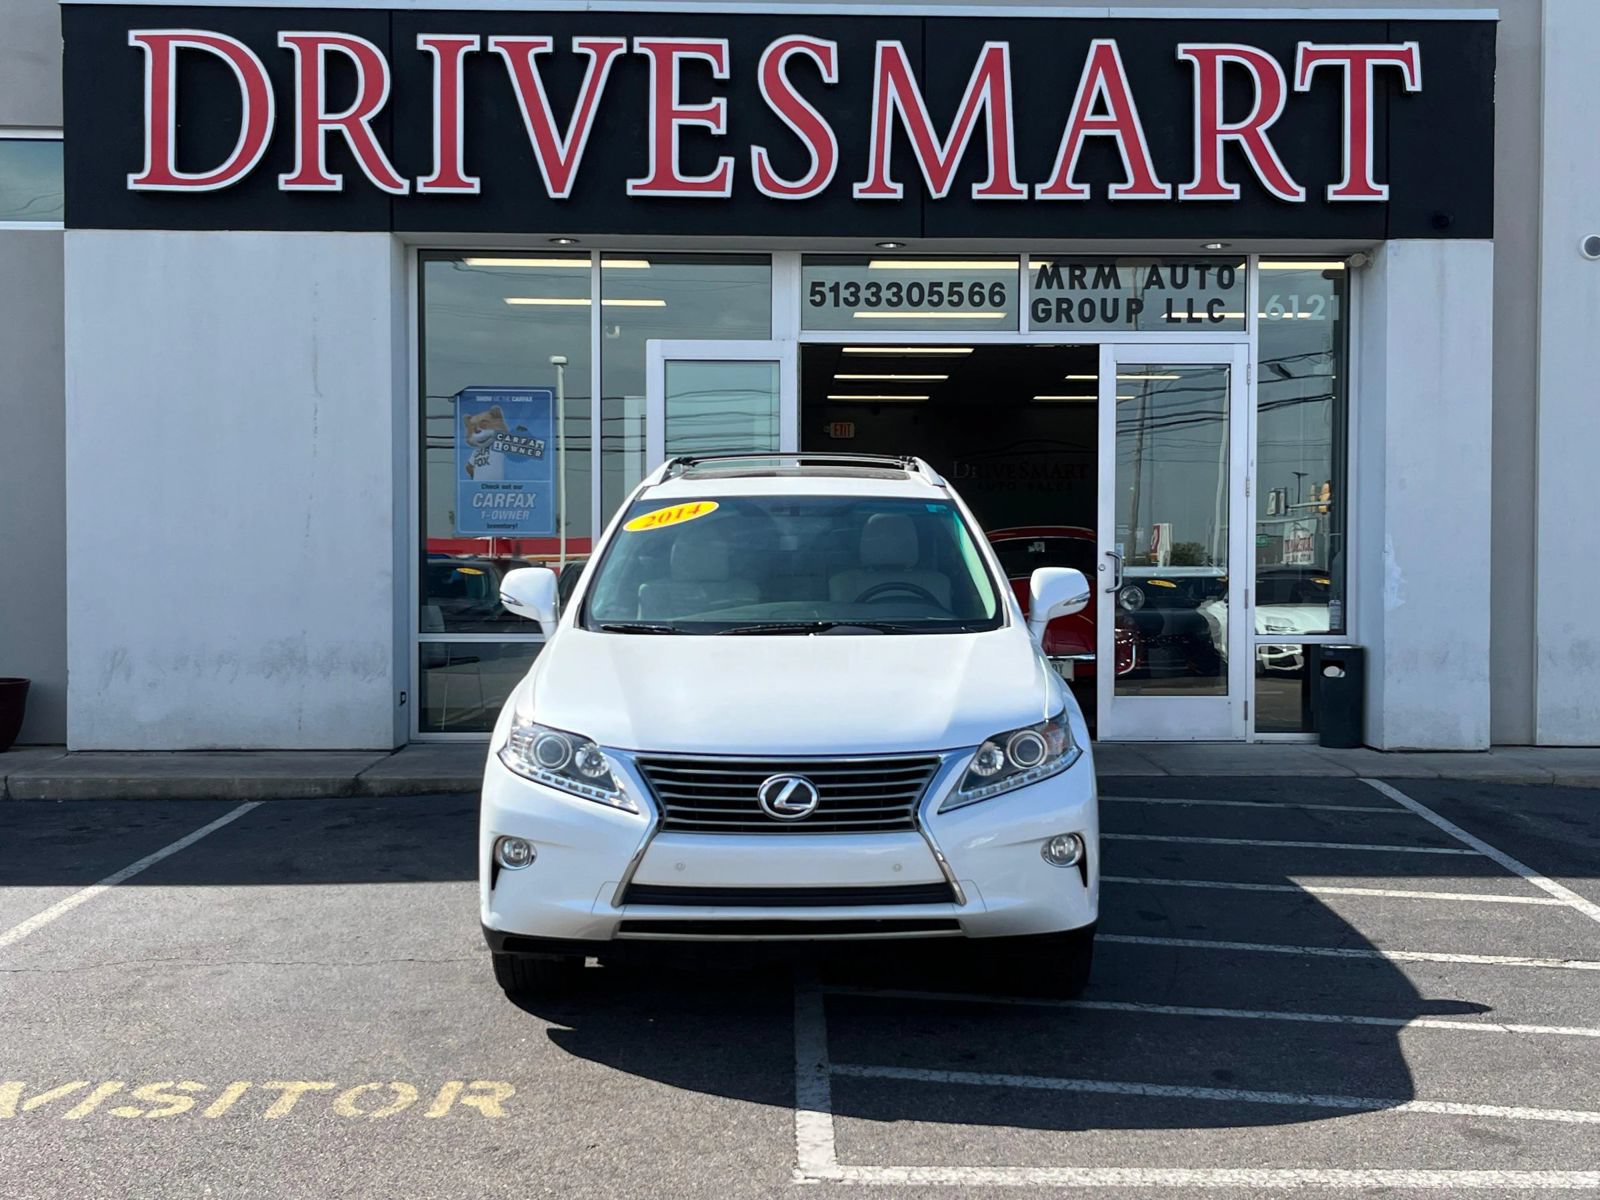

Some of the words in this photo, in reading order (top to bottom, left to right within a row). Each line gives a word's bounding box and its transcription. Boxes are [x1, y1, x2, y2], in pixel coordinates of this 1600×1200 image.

[126, 28, 1423, 204] DRIVESMART
[1034, 264, 1122, 290] MRM
[1143, 263, 1237, 290] AUTO
[808, 281, 1007, 308] 5133305566
[1264, 294, 1340, 321] 6121
[1031, 298, 1145, 324] GROUP
[1165, 298, 1226, 324] LLC
[834, 423, 851, 437] EXIT
[472, 492, 536, 509] CARFAX
[480, 510, 530, 521] 1-OWNER
[643, 504, 702, 528] 2014
[0, 1080, 516, 1120] VISITOR
